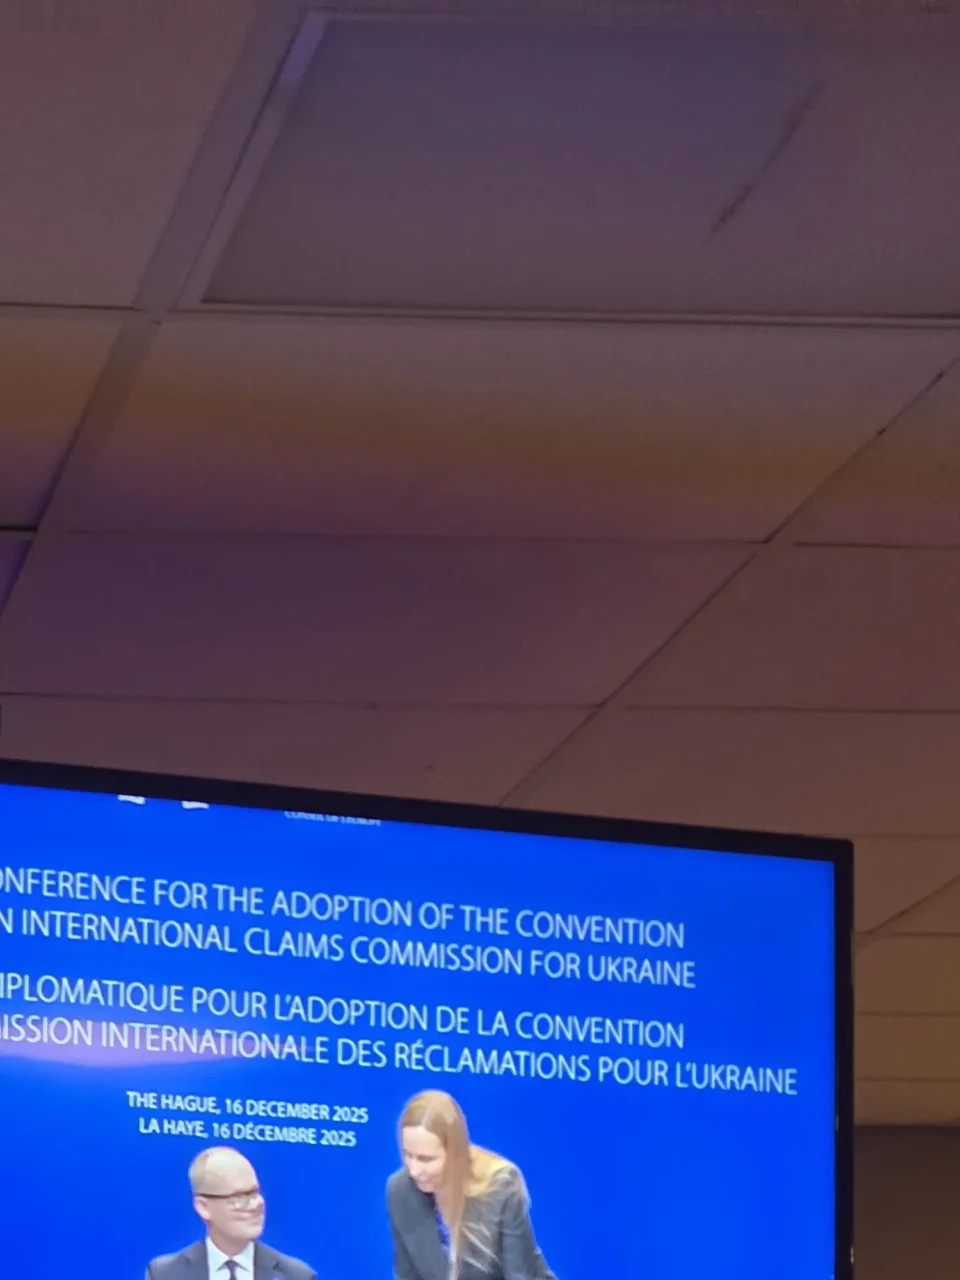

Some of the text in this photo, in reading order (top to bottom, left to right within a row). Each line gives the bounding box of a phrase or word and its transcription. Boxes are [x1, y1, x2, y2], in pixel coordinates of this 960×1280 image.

[153, 878, 208, 910] FOR
[212, 883, 264, 915] THE
[271, 890, 412, 927] ADOPTION
[418, 901, 454, 930] OF
[459, 904, 510, 936] THE
[515, 909, 684, 949] CONVENTION
[22, 908, 238, 953] INTERNATIONAL
[243, 927, 345, 962] CLAIMS
[350, 935, 523, 975] COMMISSION
[530, 949, 581, 979] FOR
[587, 954, 696, 989] UKRAINE
[192, 986, 267, 1019] POUR
[436, 1005, 470, 1035] DE
[477, 1009, 510, 1037] LA
[515, 1011, 684, 1049] CONVENTION
[101, 1021, 330, 1064] INTERNATIONALE
[337, 1037, 388, 1068] DES
[394, 1038, 592, 1082] RÉCLAMATIONS
[598, 1055, 669, 1087] POUR
[125, 1090, 369, 1124] THE HAGUE, 16 DECEMBER 2025
[138, 1116, 357, 1148] LA HAYE, 16 DÉCEMBRE 2025
